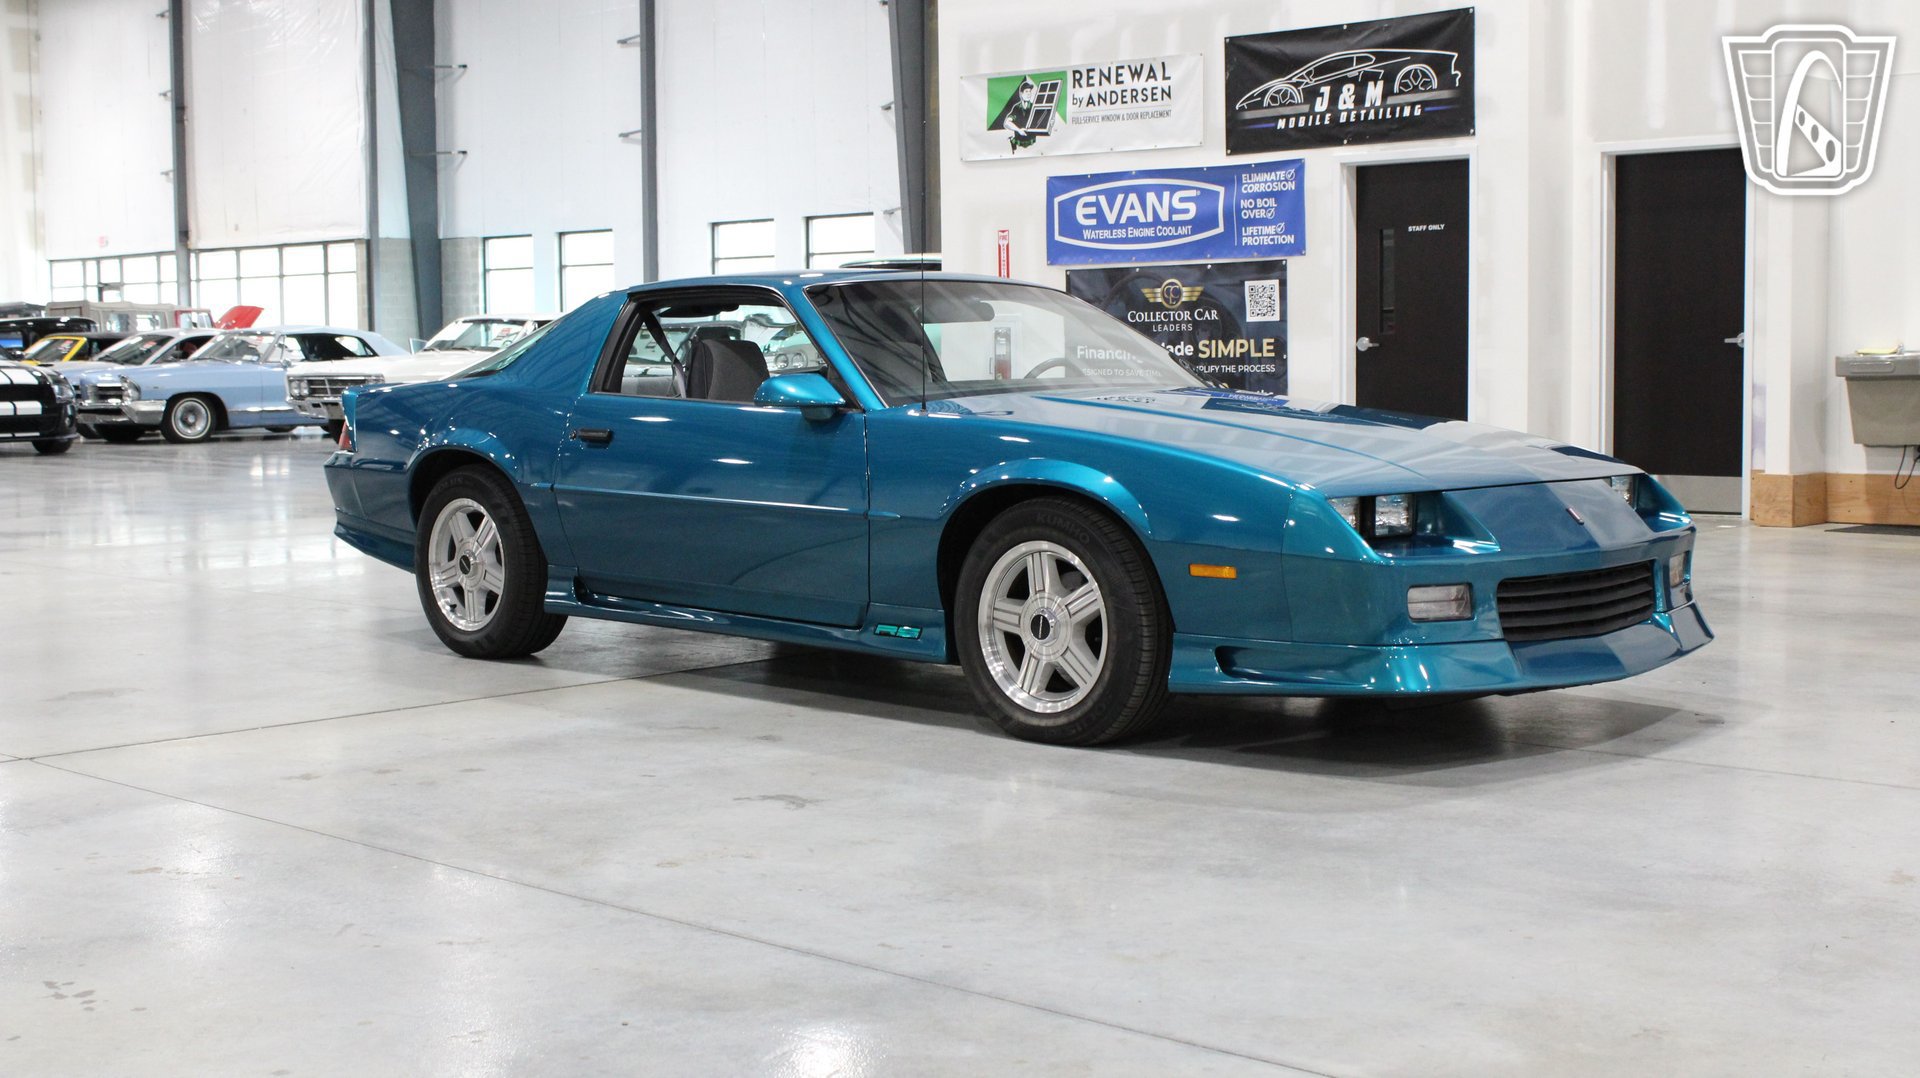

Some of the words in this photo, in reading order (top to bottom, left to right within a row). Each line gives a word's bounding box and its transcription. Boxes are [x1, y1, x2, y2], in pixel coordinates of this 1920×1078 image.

[1072, 61, 1172, 89] RENEWAL
[1072, 94, 1084, 108] by
[1086, 86, 1172, 108] ANDERSEN
[1314, 85, 1331, 112] J
[1338, 83, 1355, 111] &
[1365, 80, 1384, 107] M
[1101, 113, 1120, 122] WINDOW
[1126, 111, 1139, 121] DOOR
[1140, 109, 1172, 120] REPLACEMENT
[1277, 113, 1331, 130] MOBILE
[1339, 104, 1422, 123] DETAILING
[1242, 170, 1285, 184] ELIMINATE
[1241, 181, 1295, 193] CORROSION
[1075, 190, 1197, 226] EVANS
[1241, 199, 1254, 209] NO
[1256, 198, 1277, 208] BOIL
[1241, 209, 1266, 220] OVER
[1242, 225, 1276, 236] LIFETIME
[1242, 234, 1295, 246] PROTECTION
[1127, 310, 1192, 323] COLLECTOR
[1194, 308, 1219, 321] CAR
[1153, 323, 1193, 332] LEADERS
[1077, 345, 1143, 363] Financi
[1161, 341, 1194, 356] ade
[1198, 338, 1275, 359] SIMPLE
[1114, 367, 1124, 377] TO
[1221, 364, 1236, 373] THE
[1238, 364, 1276, 373] PROCESS
